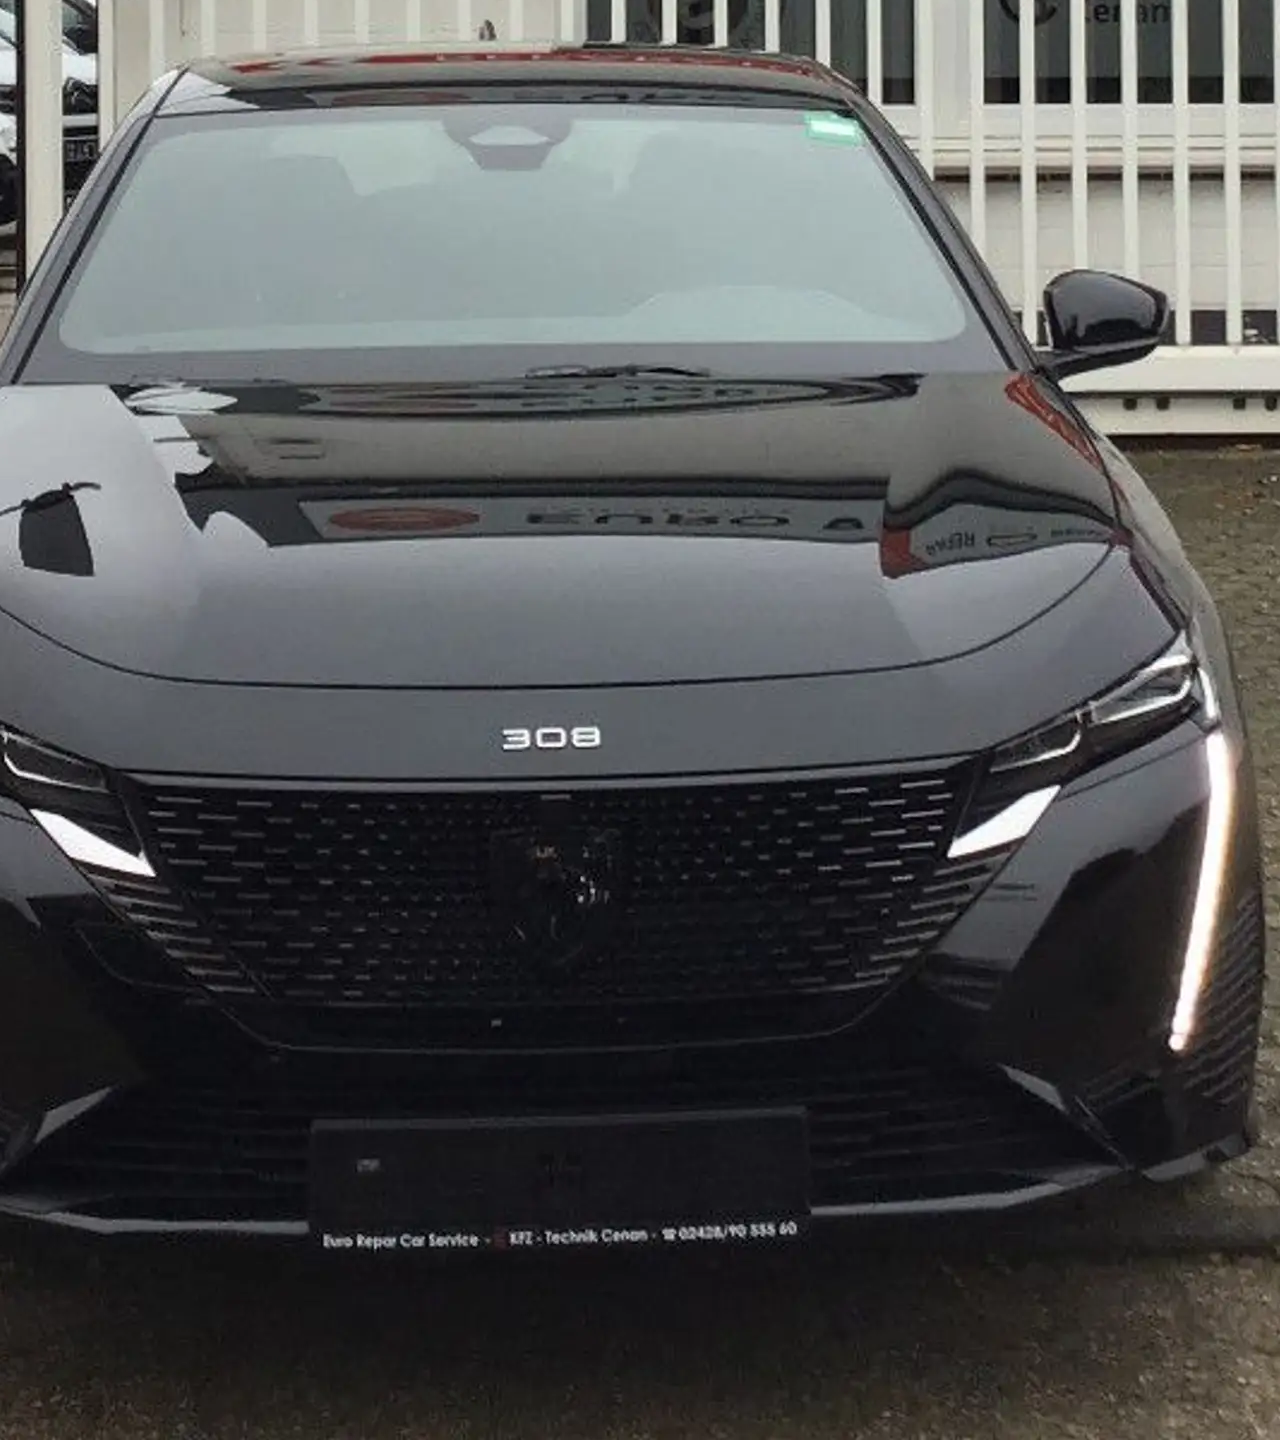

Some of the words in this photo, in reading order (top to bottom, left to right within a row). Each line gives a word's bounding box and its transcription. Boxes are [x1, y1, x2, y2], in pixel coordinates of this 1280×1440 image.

[502, 726, 601, 750] 308
[322, 1233, 354, 1249] Euro
[357, 1233, 397, 1253] Repar
[400, 1232, 425, 1249] Car
[428, 1231, 480, 1248] Service
[509, 1230, 534, 1246] KFZ
[544, 1229, 598, 1246] Technik
